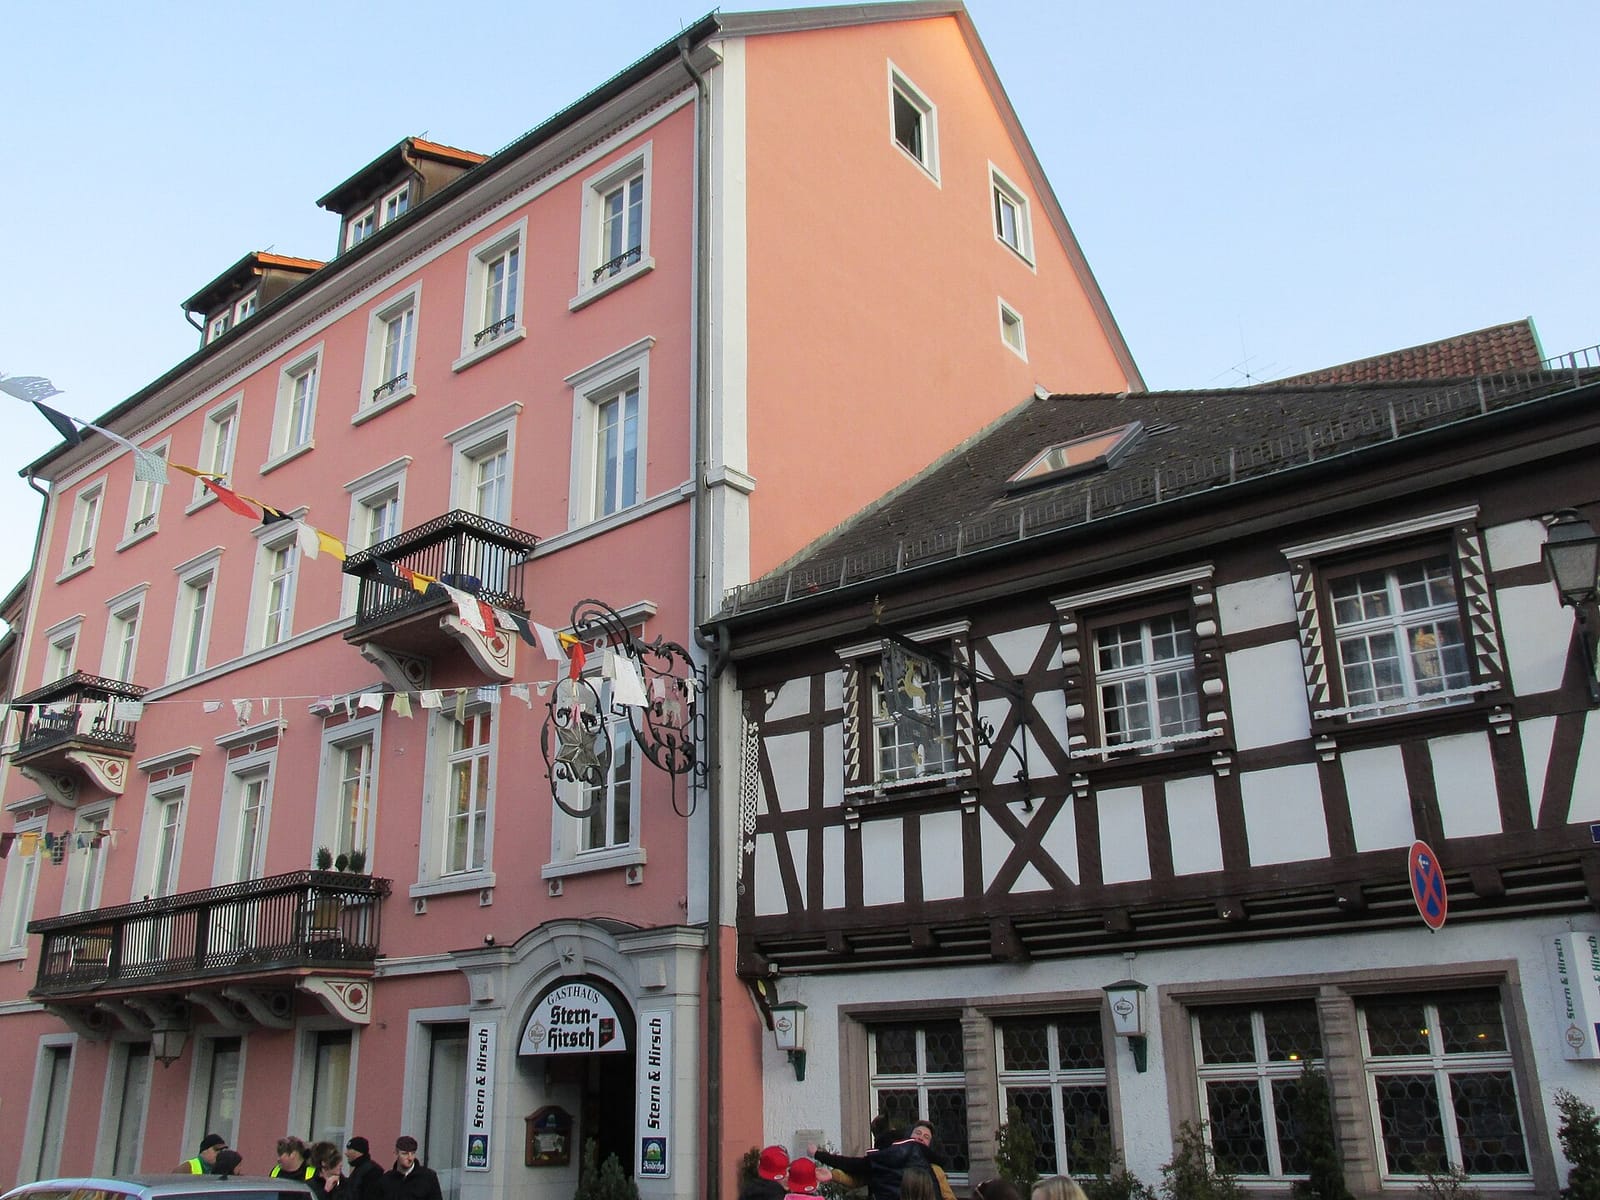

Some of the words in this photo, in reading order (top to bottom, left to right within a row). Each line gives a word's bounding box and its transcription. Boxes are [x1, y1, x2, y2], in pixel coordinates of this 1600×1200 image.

[1553, 938, 1568, 974] Hirsch
[547, 986, 600, 1006] GASTHAUS
[1560, 977, 1569, 986] &
[550, 1005, 598, 1025] Stern-
[1564, 987, 1576, 1020] Stern
[476, 1028, 489, 1072] Hirsch
[548, 1026, 595, 1052] Hirsch
[648, 1018, 661, 1066] Hirsch
[476, 1076, 486, 1086] &
[648, 1071, 661, 1082] &
[473, 1090, 486, 1128] Stern
[648, 1086, 661, 1129] Stern
